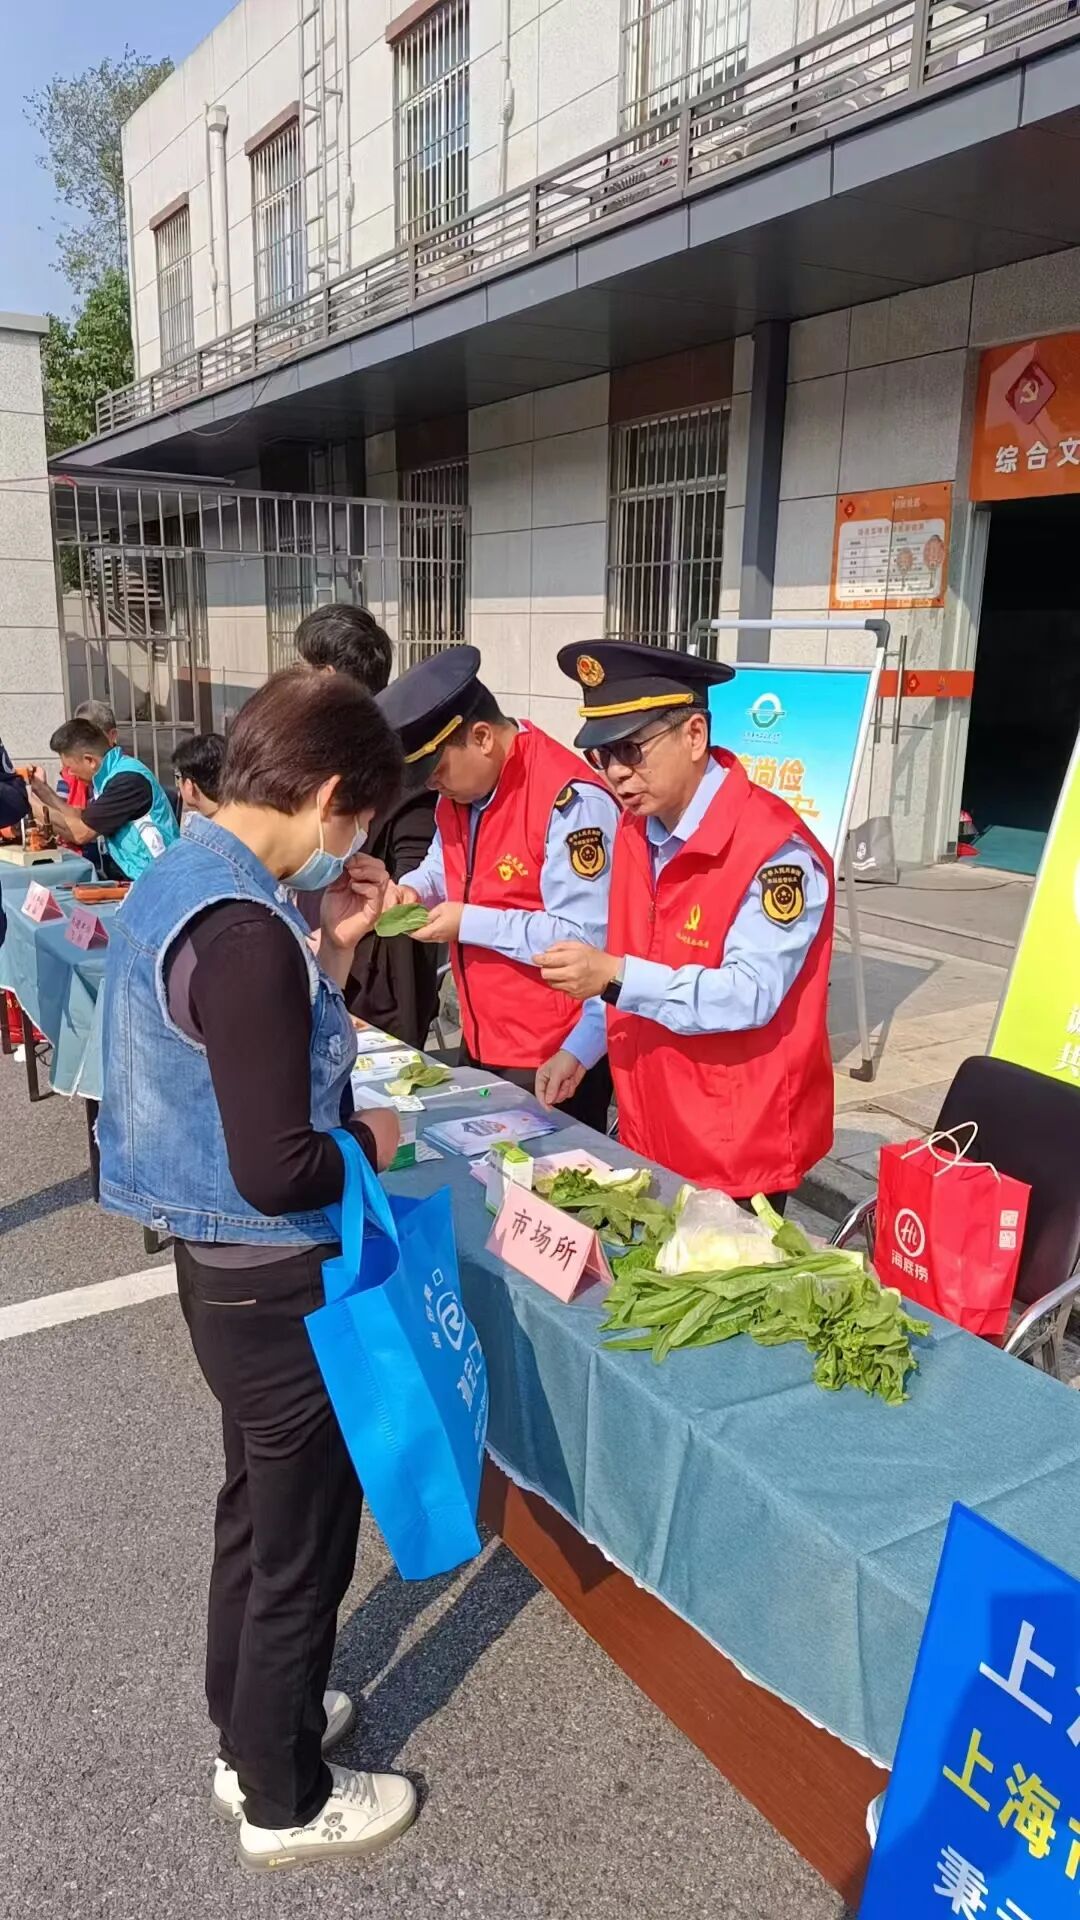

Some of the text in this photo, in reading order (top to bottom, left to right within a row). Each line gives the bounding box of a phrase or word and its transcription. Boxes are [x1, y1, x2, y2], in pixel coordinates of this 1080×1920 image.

[994, 436, 1080, 473] 综合文
[511, 1208, 578, 1272] 市场所
[891, 1248, 929, 1283] 海底捞
[979, 1619, 1080, 1746] 上
[933, 1845, 1033, 1920] 秉
